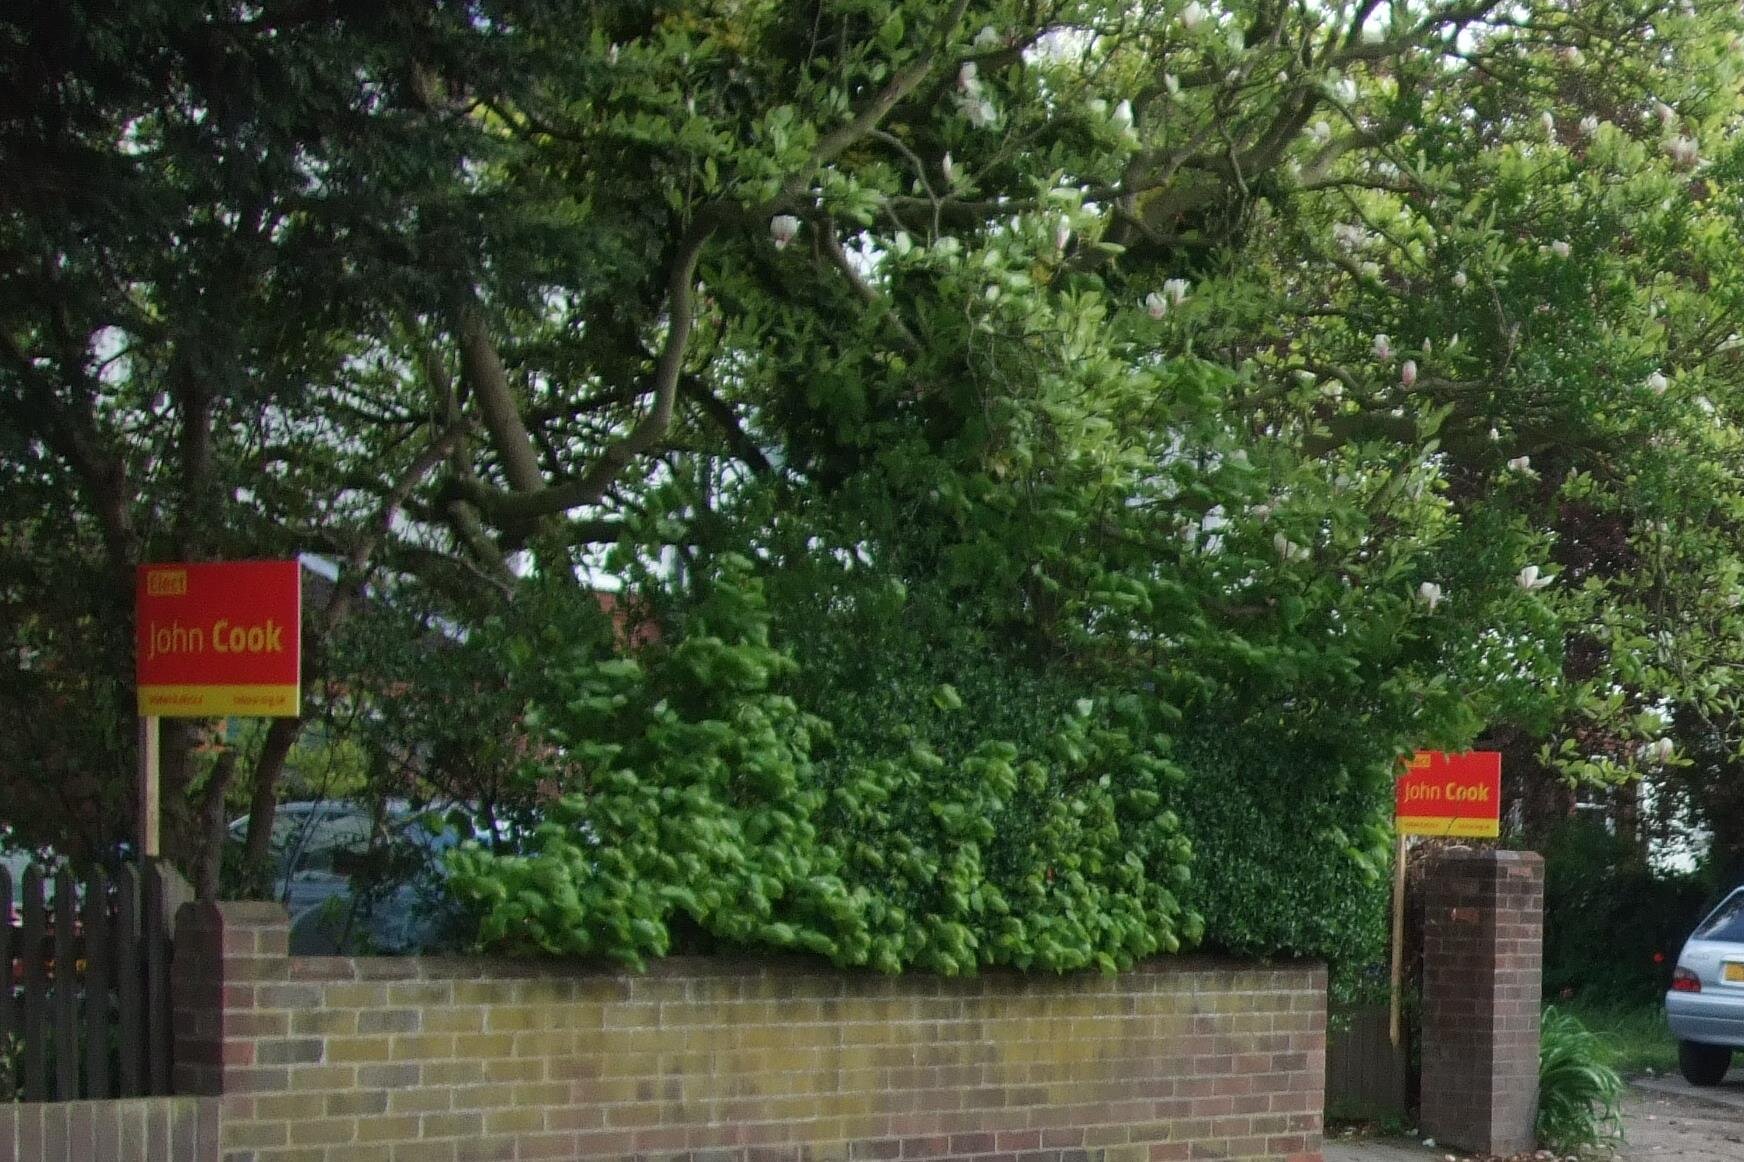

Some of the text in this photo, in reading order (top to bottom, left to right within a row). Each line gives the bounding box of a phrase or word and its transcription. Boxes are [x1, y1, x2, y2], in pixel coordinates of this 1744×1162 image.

[147, 617, 283, 661] John Cook
[1403, 780, 1490, 803] John Cook
